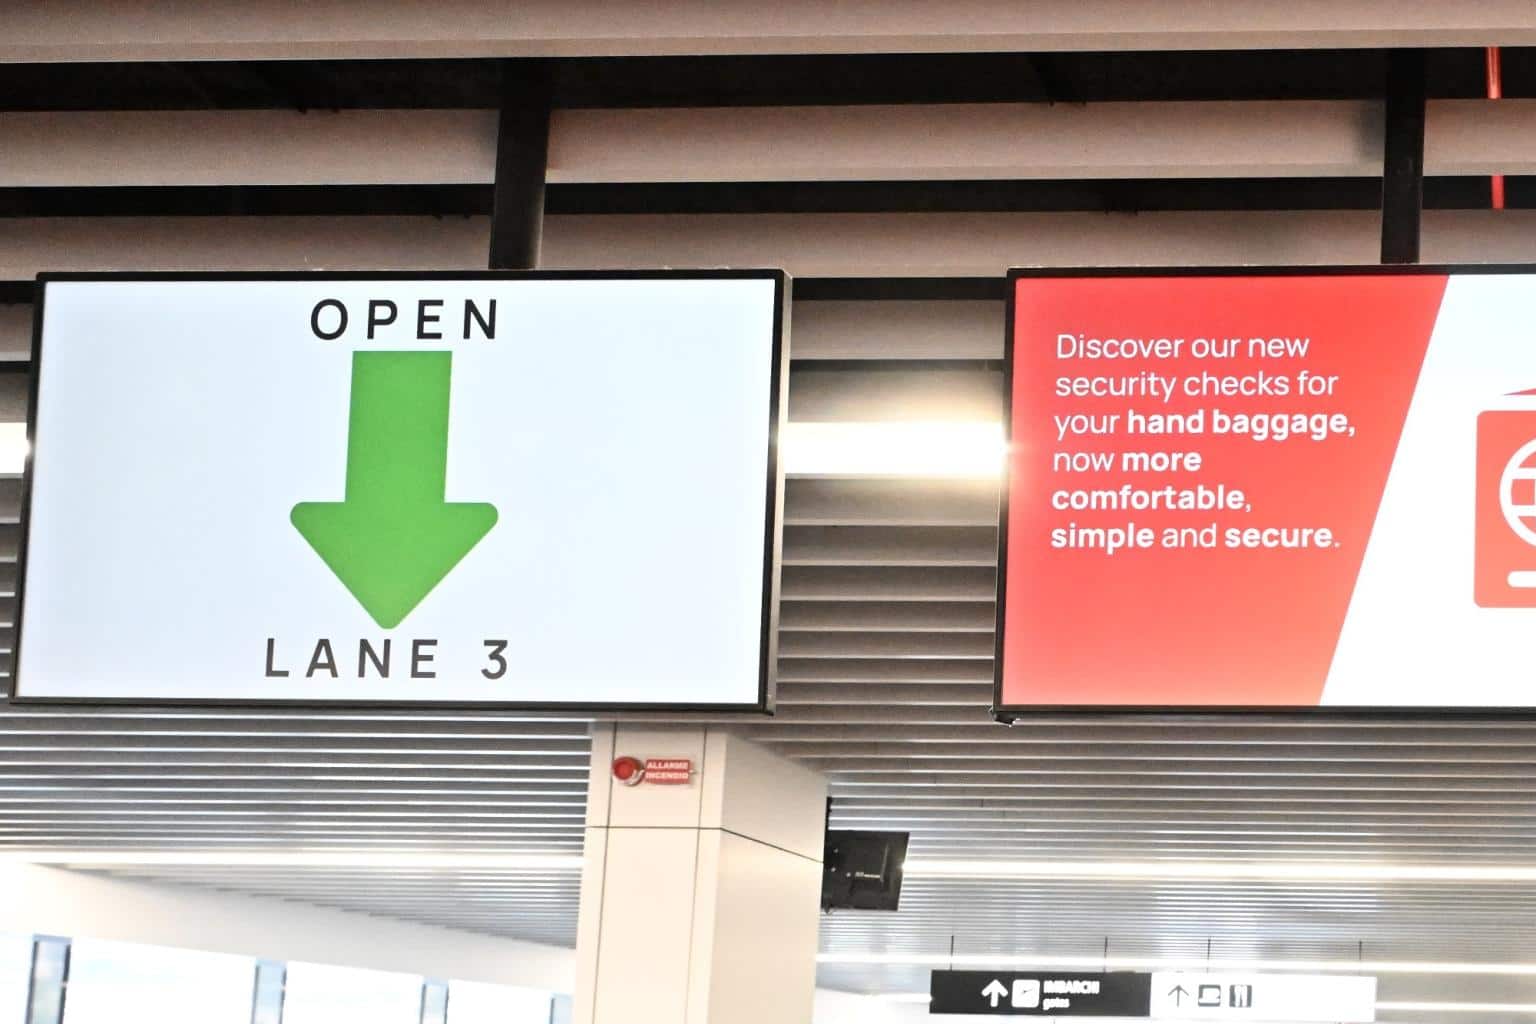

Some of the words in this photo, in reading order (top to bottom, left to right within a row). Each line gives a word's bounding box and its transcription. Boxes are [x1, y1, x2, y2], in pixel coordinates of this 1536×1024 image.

[310, 298, 497, 340] OPEN
[1056, 334, 1184, 359] Discover
[1191, 338, 1240, 359] our
[1248, 338, 1310, 358] new
[1055, 371, 1177, 403] security
[1183, 371, 1289, 396] checks
[1297, 371, 1339, 395] for
[1053, 413, 1120, 441] your
[1127, 409, 1204, 434] hand
[1212, 409, 1356, 441] baggage,
[1053, 452, 1114, 472] now
[1121, 451, 1202, 472] more
[1051, 484, 1252, 513] comfortable,
[1050, 523, 1155, 554] simple
[1161, 523, 1217, 548] and
[1224, 526, 1341, 548] secure.
[264, 638, 438, 679] LANE
[480, 639, 509, 680] 3
[645, 771, 689, 780] INCENDIO
[646, 761, 689, 769] ALLARME
